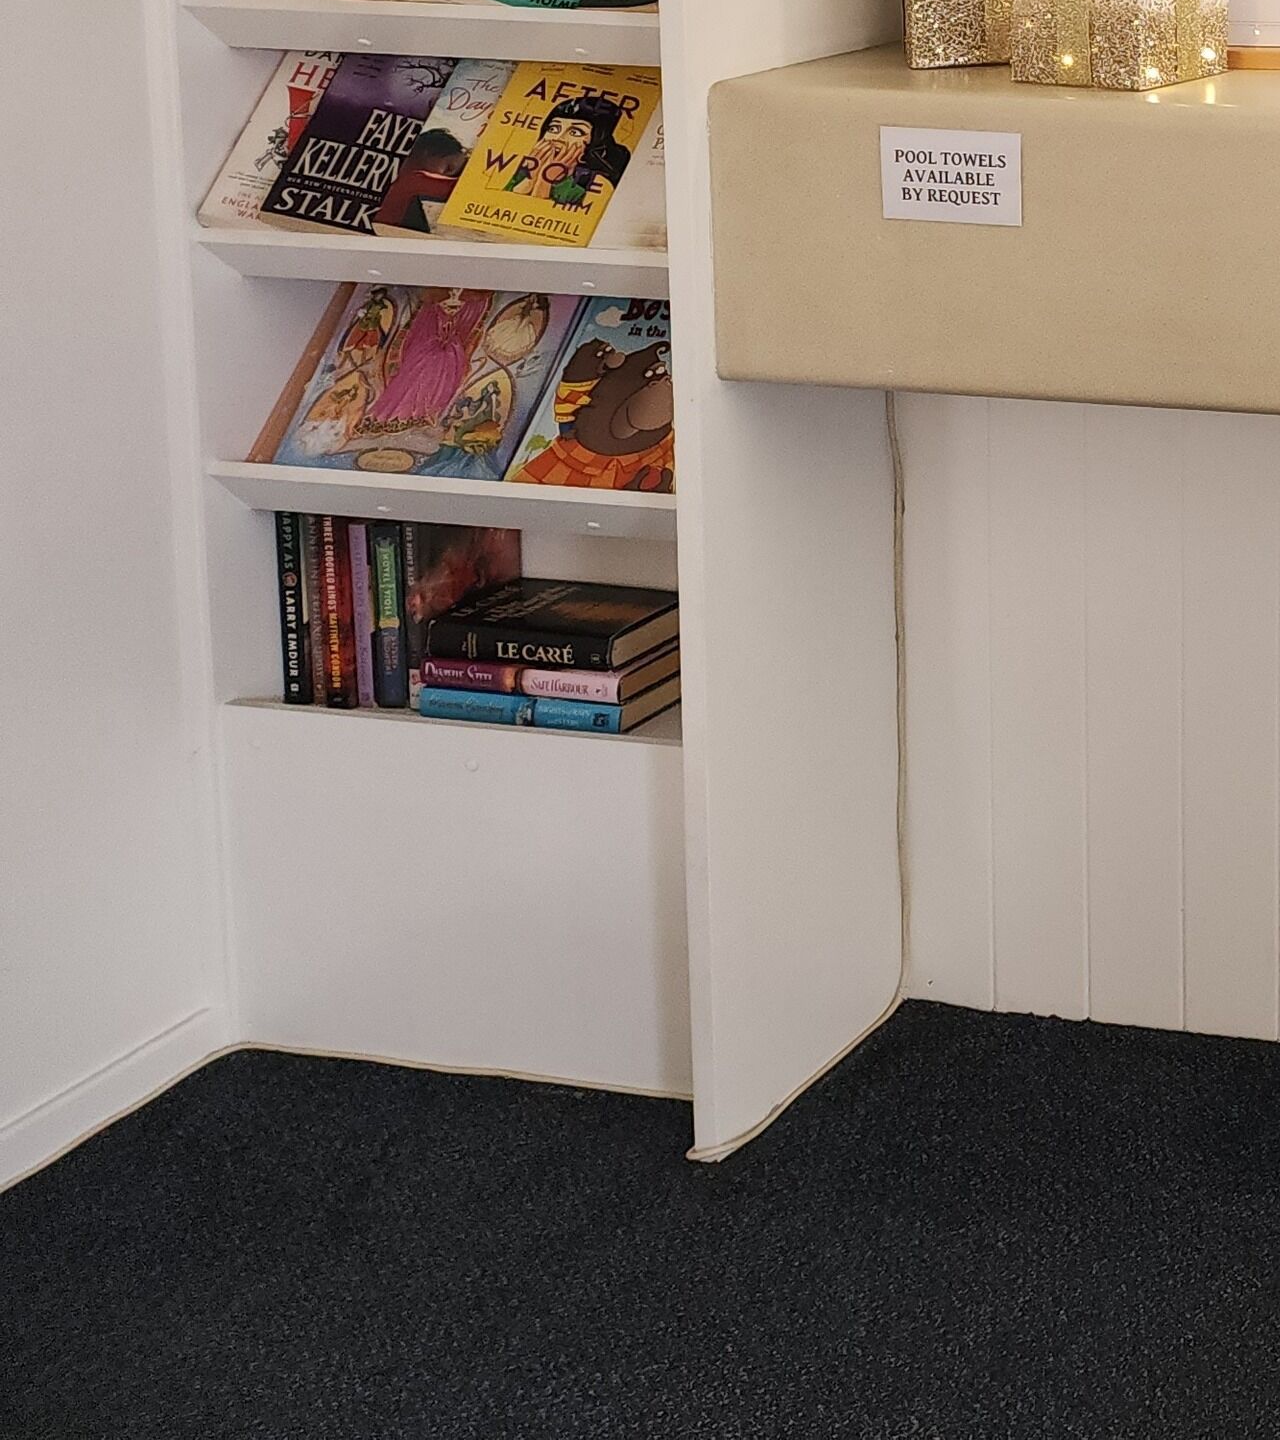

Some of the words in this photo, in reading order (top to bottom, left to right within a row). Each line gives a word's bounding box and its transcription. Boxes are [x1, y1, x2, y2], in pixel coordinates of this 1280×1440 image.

[524, 76, 641, 120] AFTER
[356, 109, 424, 156] FAYE
[500, 110, 543, 132] SHE
[894, 149, 938, 165] POOL
[940, 151, 1007, 169] TOWELS
[903, 168, 996, 187] AVAILABLE
[272, 187, 382, 231] STALK
[901, 187, 923, 202] BY
[927, 188, 1002, 206] REQUEST
[464, 202, 518, 224] SULARI
[520, 213, 581, 237] GENTILL
[627, 323, 643, 336] in
[646, 325, 667, 338] the
[323, 516, 333, 542] THREE
[284, 553, 294, 570] AS
[324, 544, 336, 583] CROOKED
[286, 589, 297, 629] LARRY
[326, 585, 337, 610] KINGS
[328, 611, 340, 653] MATTHEW
[287, 633, 299, 677] EMDUR
[496, 641, 519, 660] LE
[521, 643, 575, 665] CARRÉ
[331, 653, 342, 689] CONDON
